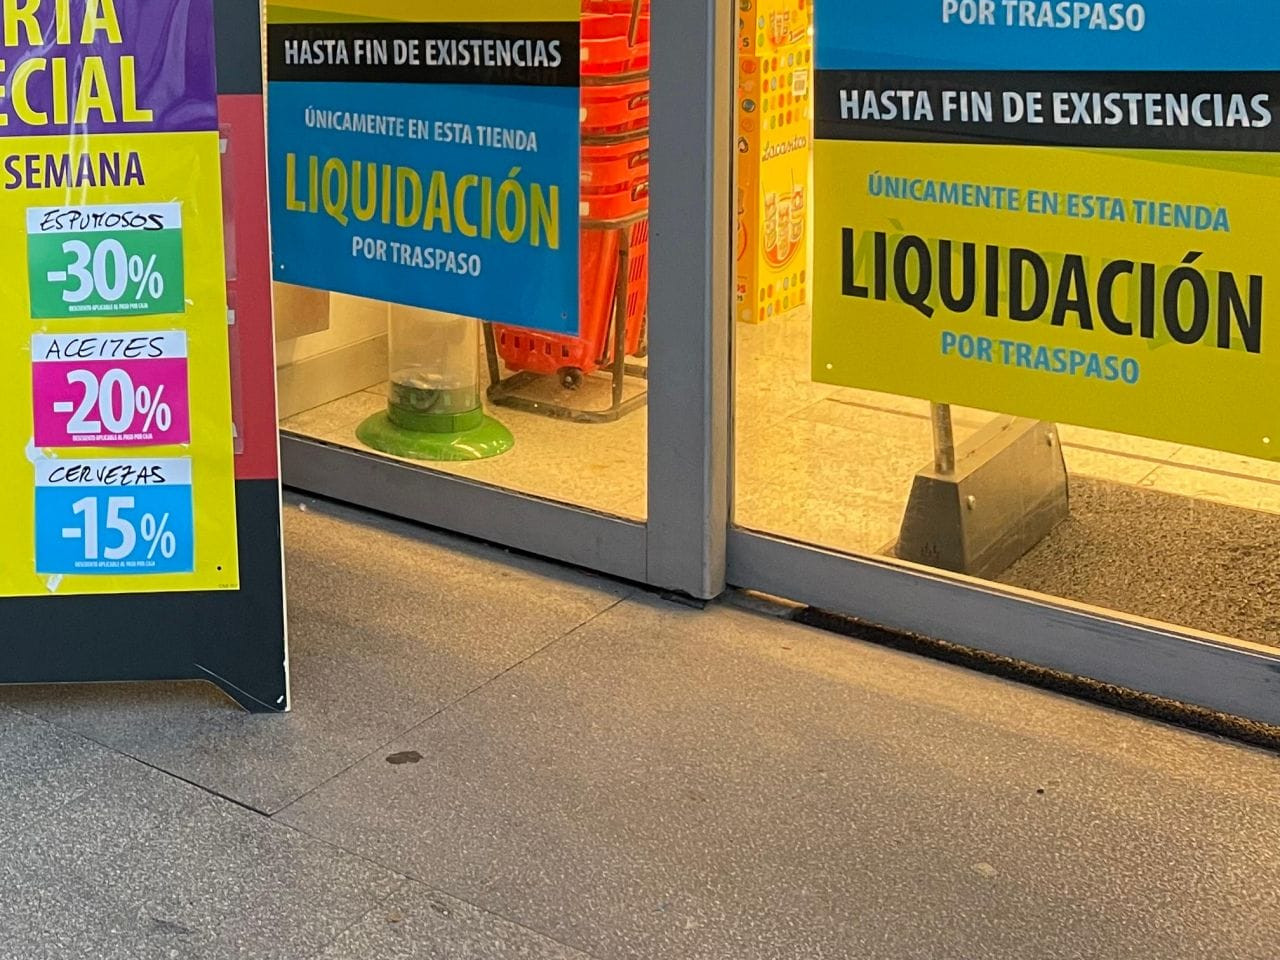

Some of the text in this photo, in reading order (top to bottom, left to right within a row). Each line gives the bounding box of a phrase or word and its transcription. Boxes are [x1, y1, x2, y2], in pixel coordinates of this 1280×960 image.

[1001, 0, 1146, 32] TRASPASO
[285, 40, 561, 68] HASTA FIN DE EXISTENCIAS
[305, 106, 537, 152] ÚNICAMENTE EN ESTA TIENDA
[839, 88, 1272, 128] HASTA FIN DE EXISTENCIAS
[4, 151, 146, 190] SEMANA
[40, 209, 164, 231] ESPUMOSOS
[286, 152, 559, 250] LIQUIDACIÓN
[867, 170, 1230, 232] ÚNICAMENTE EN ESTA TIENDA
[47, 238, 164, 303] -30%
[352, 236, 481, 277] POR TRASPASO
[841, 226, 1263, 354] LIQUIDACIÓN
[46, 337, 164, 359] ACEITES
[941, 331, 1140, 385] POR TRASPASO
[53, 368, 172, 433] -20%
[48, 464, 166, 485] CERVEZAS
[61, 496, 176, 560] -15%
